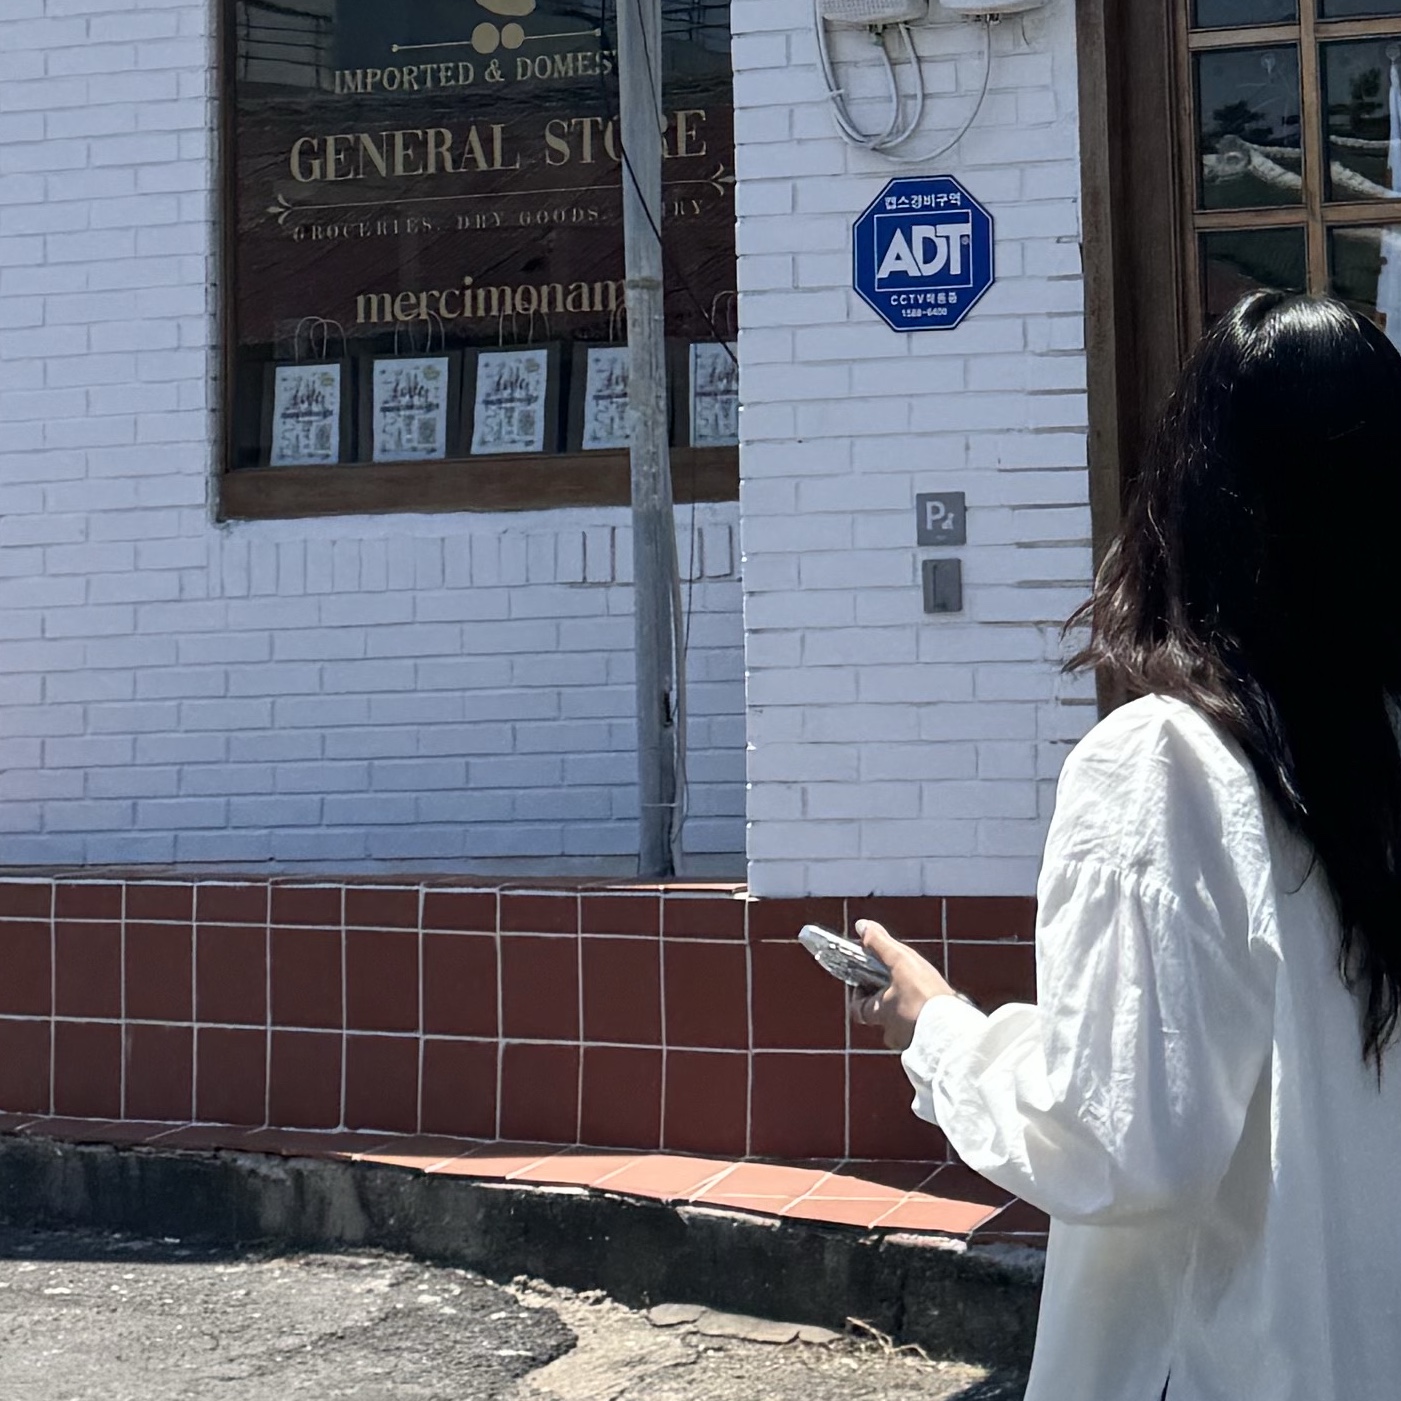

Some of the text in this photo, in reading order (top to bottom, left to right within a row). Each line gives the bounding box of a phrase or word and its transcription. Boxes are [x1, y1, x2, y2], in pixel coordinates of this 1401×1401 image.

[334, 50, 618, 95] IMPORTED & DOMES
[289, 123, 521, 183] GENERAL
[457, 210, 504, 231] DRY
[884, 191, 962, 210] 캡스경비구역
[877, 223, 972, 279] ADT
[357, 275, 627, 323] mercimonam
[926, 500, 946, 531] P
